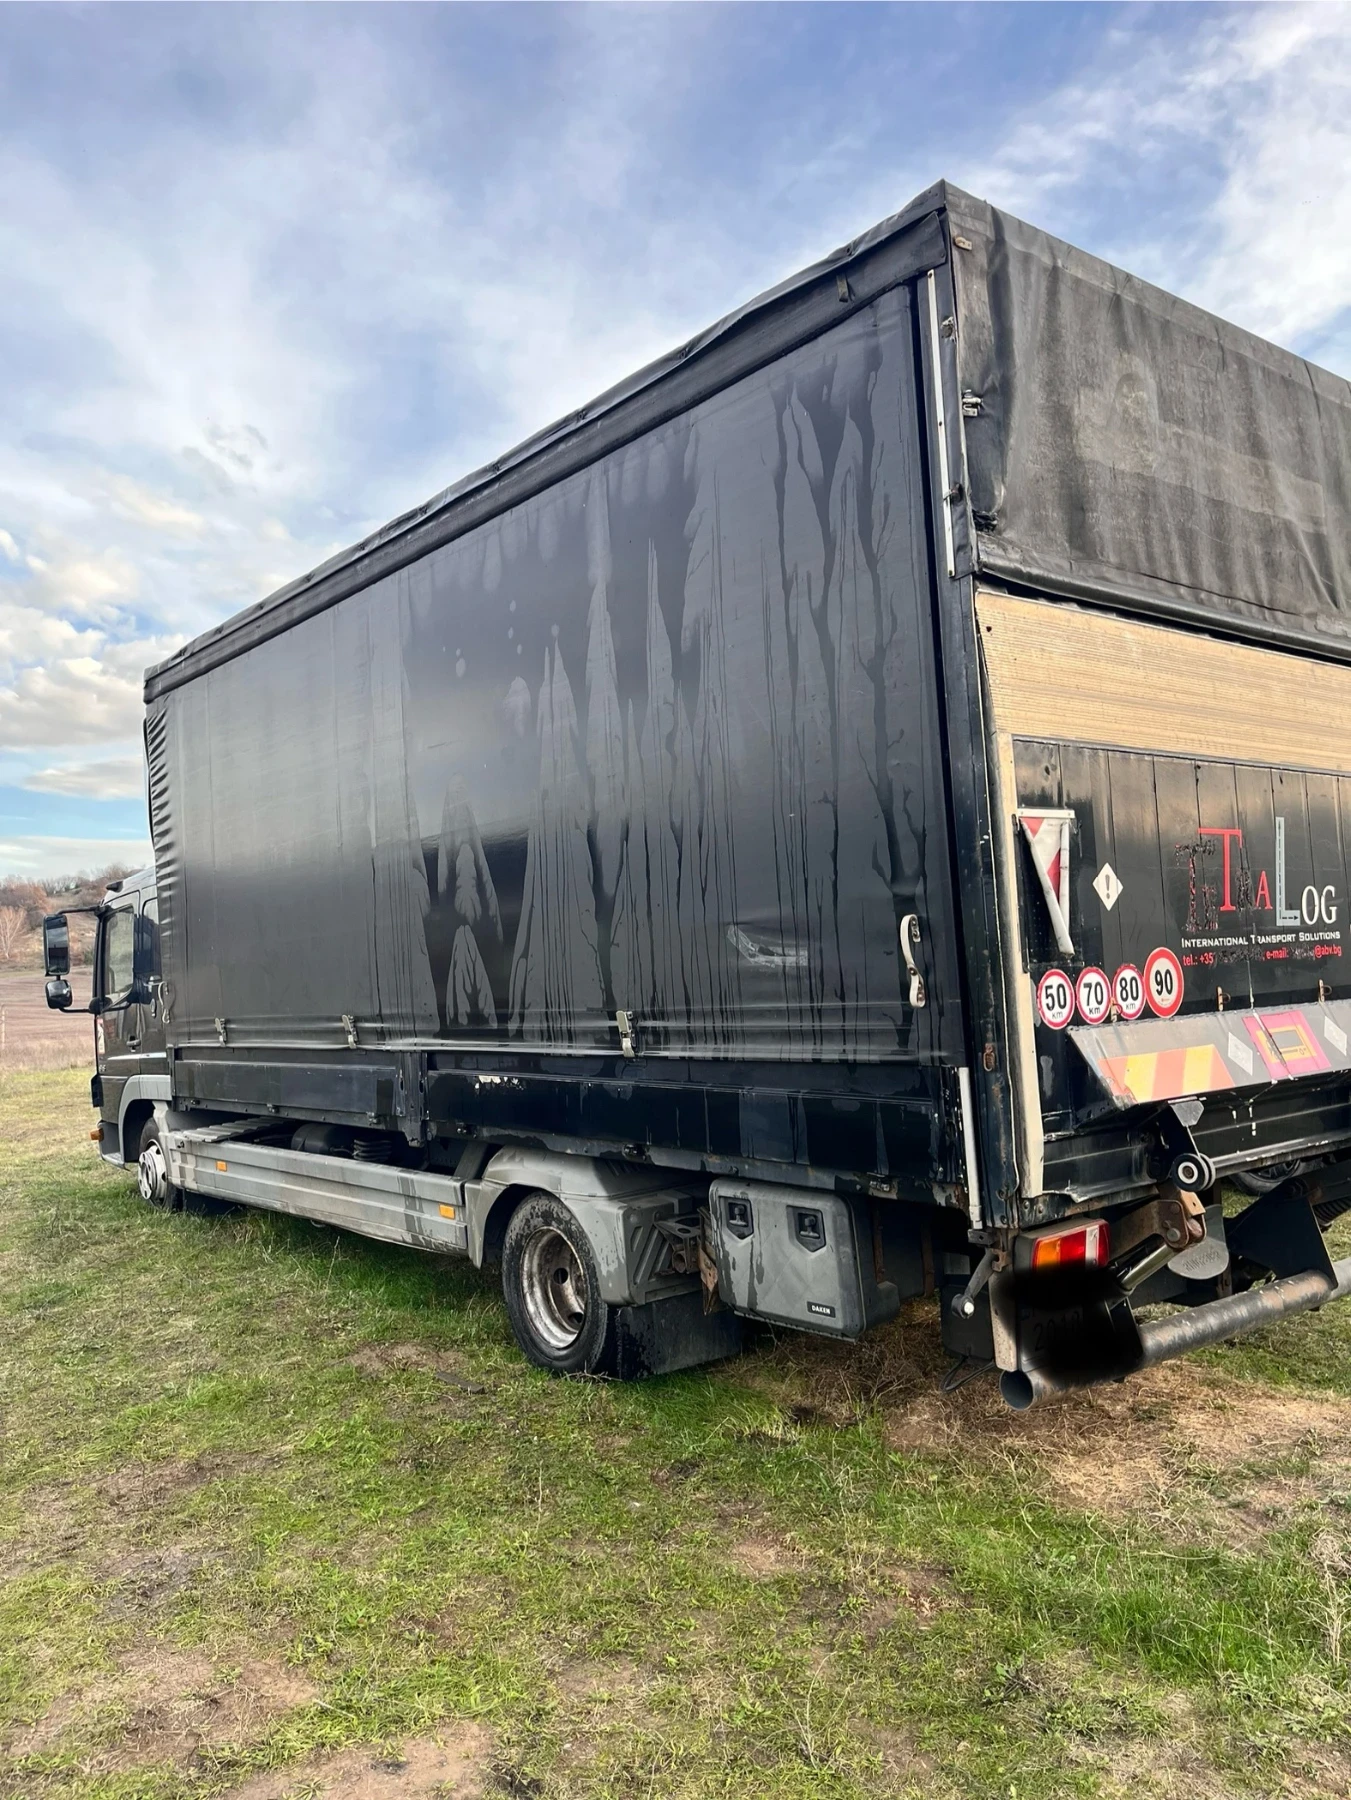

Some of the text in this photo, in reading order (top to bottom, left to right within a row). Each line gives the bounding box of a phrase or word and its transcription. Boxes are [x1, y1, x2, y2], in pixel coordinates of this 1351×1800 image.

[1298, 930, 1341, 942] SOLUTIONS
[1083, 981, 1104, 1007] 70
[1120, 976, 1139, 1002] 80
[1154, 969, 1173, 996] 90
[1045, 983, 1067, 1011] 50
